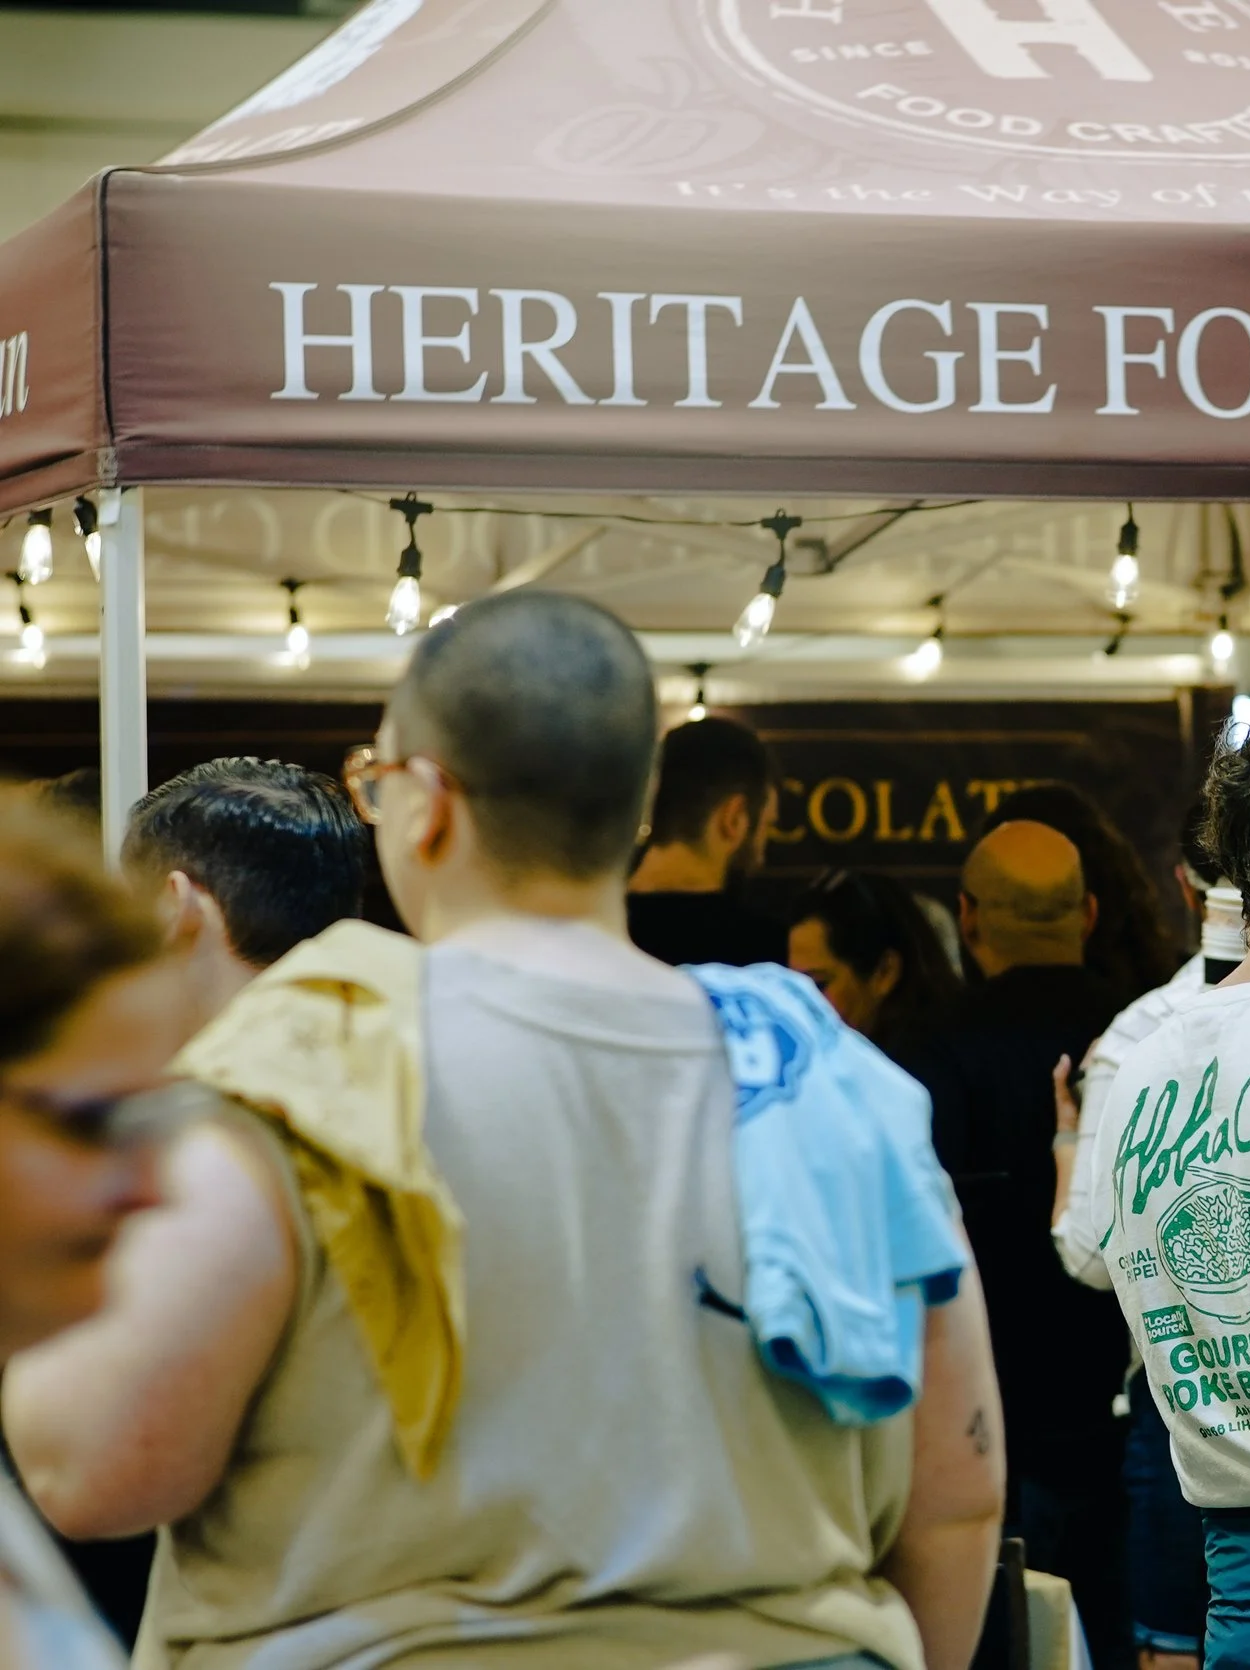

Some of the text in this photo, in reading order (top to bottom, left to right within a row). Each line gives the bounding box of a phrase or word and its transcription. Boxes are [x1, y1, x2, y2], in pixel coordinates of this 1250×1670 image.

[790, 40, 934, 63] SINCE
[856, 82, 1043, 137] FOOD
[823, 183, 933, 201] the
[957, 184, 1122, 208] Way
[1151, 182, 1217, 208] of
[269, 282, 1058, 414] HERITAGE
[766, 777, 1045, 842] COLAT
[1099, 1056, 1233, 1251] Aloha
[1161, 1371, 1240, 1413] POKE
